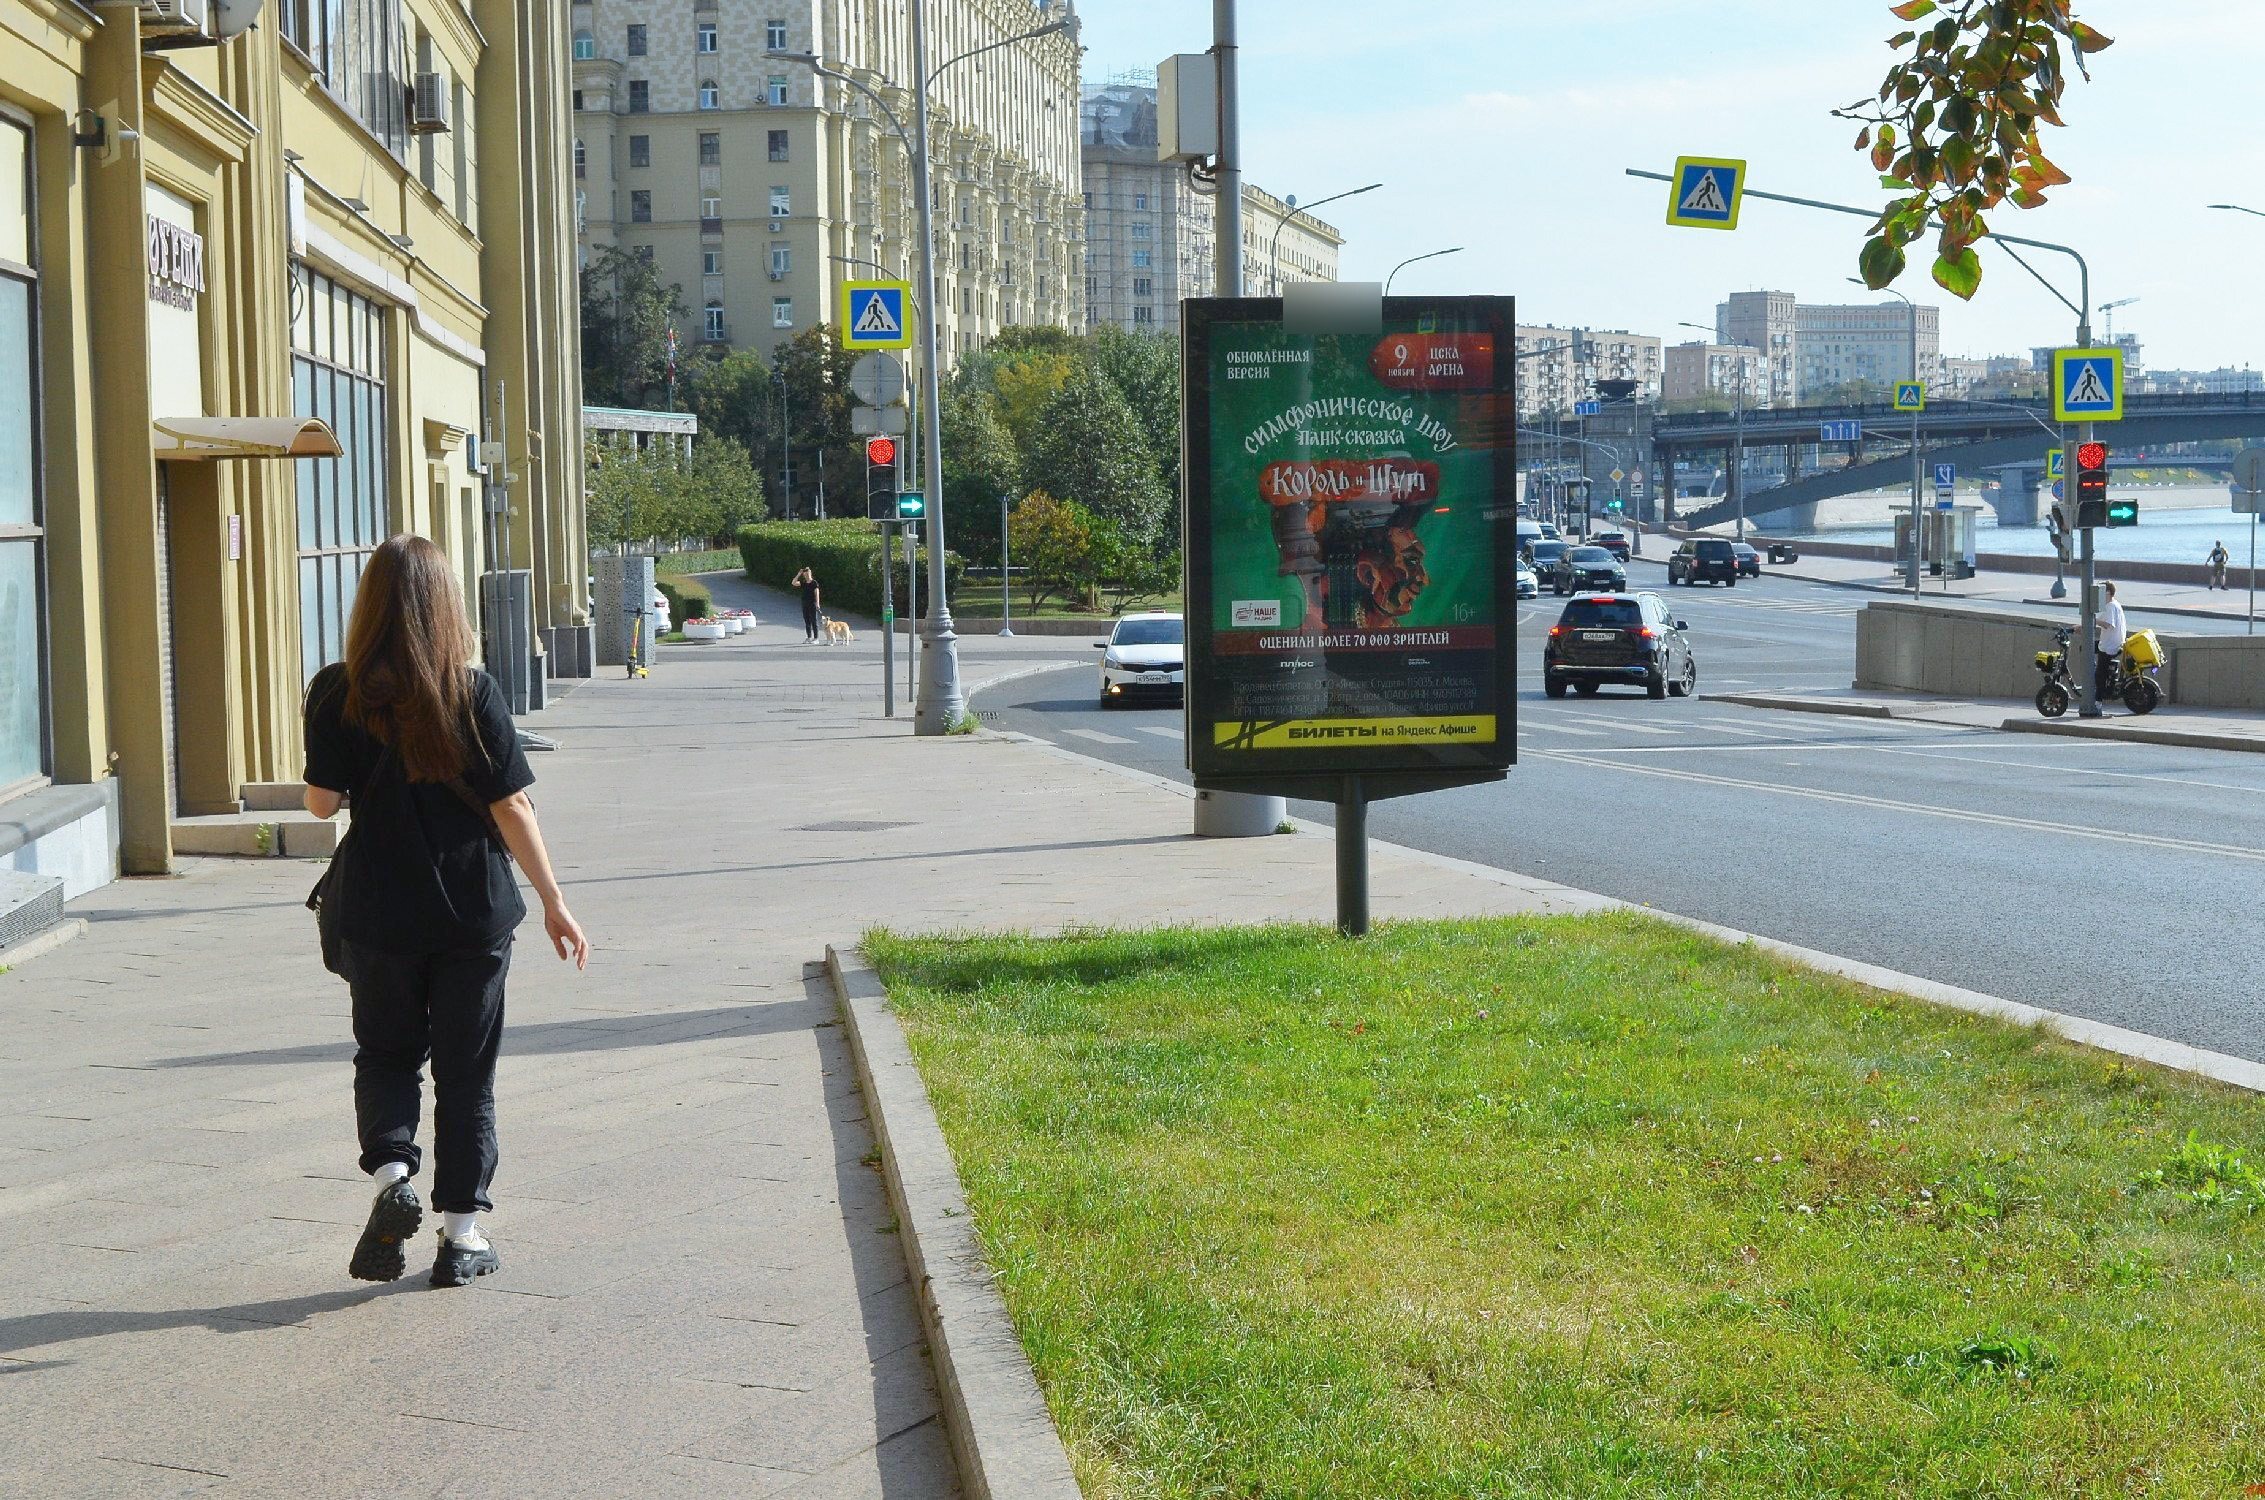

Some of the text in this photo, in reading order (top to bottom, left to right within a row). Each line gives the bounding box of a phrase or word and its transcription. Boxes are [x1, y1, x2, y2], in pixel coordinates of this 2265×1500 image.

[1227, 348, 1310, 363] ОБНОВЛЁННАЯ
[1394, 344, 1408, 367] 9
[1430, 347, 1459, 360] ЦСКА
[1227, 366, 1270, 380] ВЕРСИЯ
[1388, 368, 1415, 377] НОЯБРЯ
[1429, 363, 1464, 377] АРЕНА
[1254, 607, 1277, 616] НАШЕ
[1452, 602, 1476, 622] 16+
[1259, 631, 1450, 649] ОЦЕНИЛИ БОЛЕЕ 70 000 ЗРИТЕЛЕЙ
[1288, 724, 1477, 739] БИЛЕТЫ на Яндекс Афише
